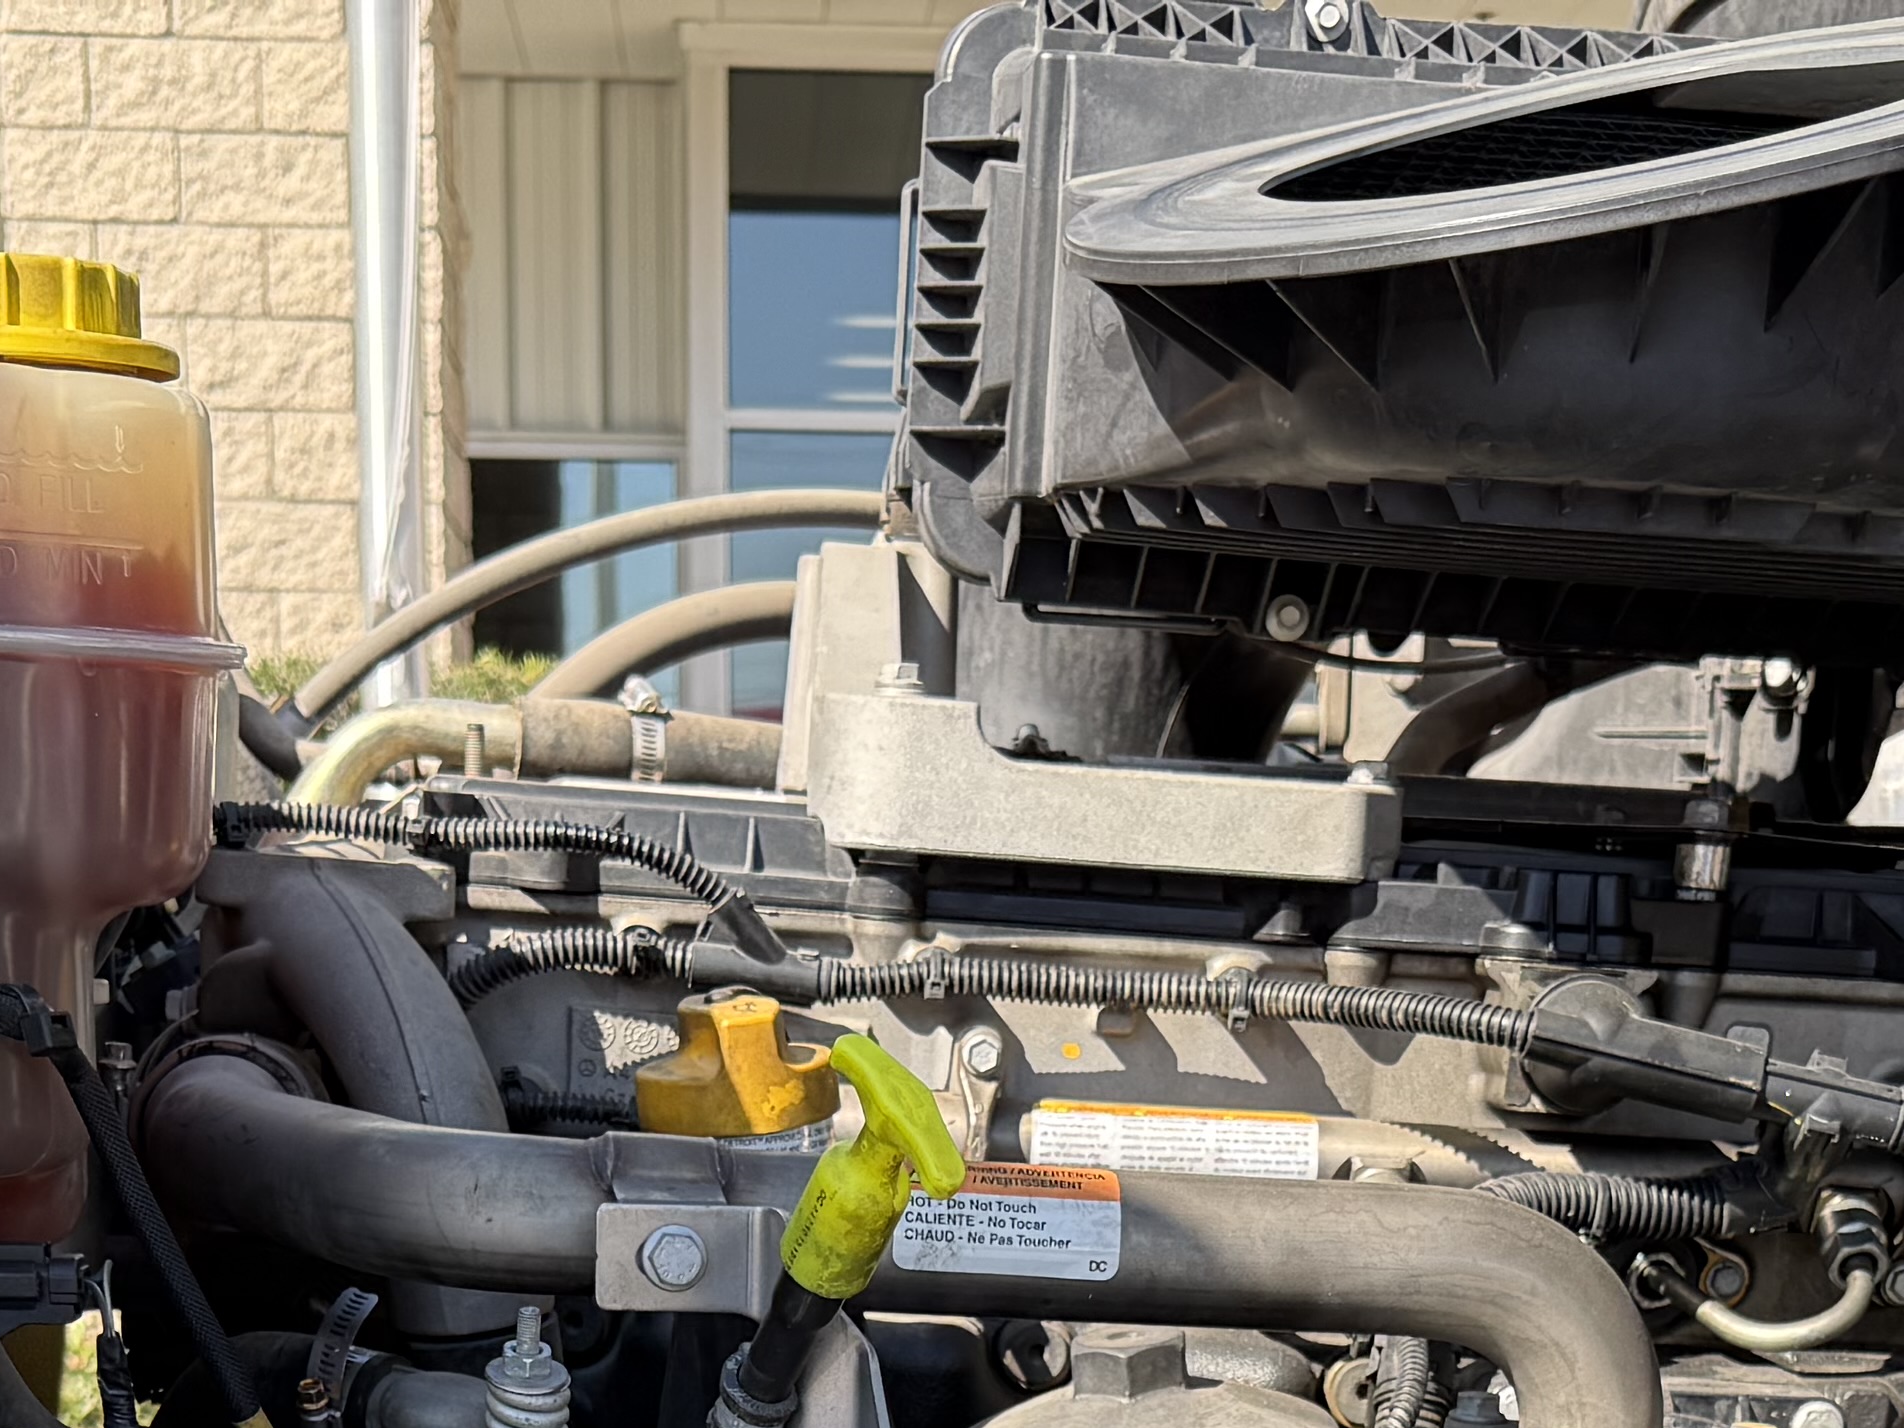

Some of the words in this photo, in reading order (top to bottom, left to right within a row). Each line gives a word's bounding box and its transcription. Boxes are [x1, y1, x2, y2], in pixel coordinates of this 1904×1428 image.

[946, 1197, 967, 1211] Do
[969, 1198, 992, 1212] Not
[994, 1200, 1037, 1214] Touch
[904, 1210, 976, 1227] CALIENTE
[987, 1217, 1006, 1229] No
[1006, 1218, 1047, 1232] Tocar
[904, 1228, 955, 1243] CHAUD
[967, 1232, 986, 1245] Ne
[988, 1233, 1014, 1247] Pas
[1015, 1235, 1071, 1250] Toucher
[1088, 1260, 1108, 1273] DC
